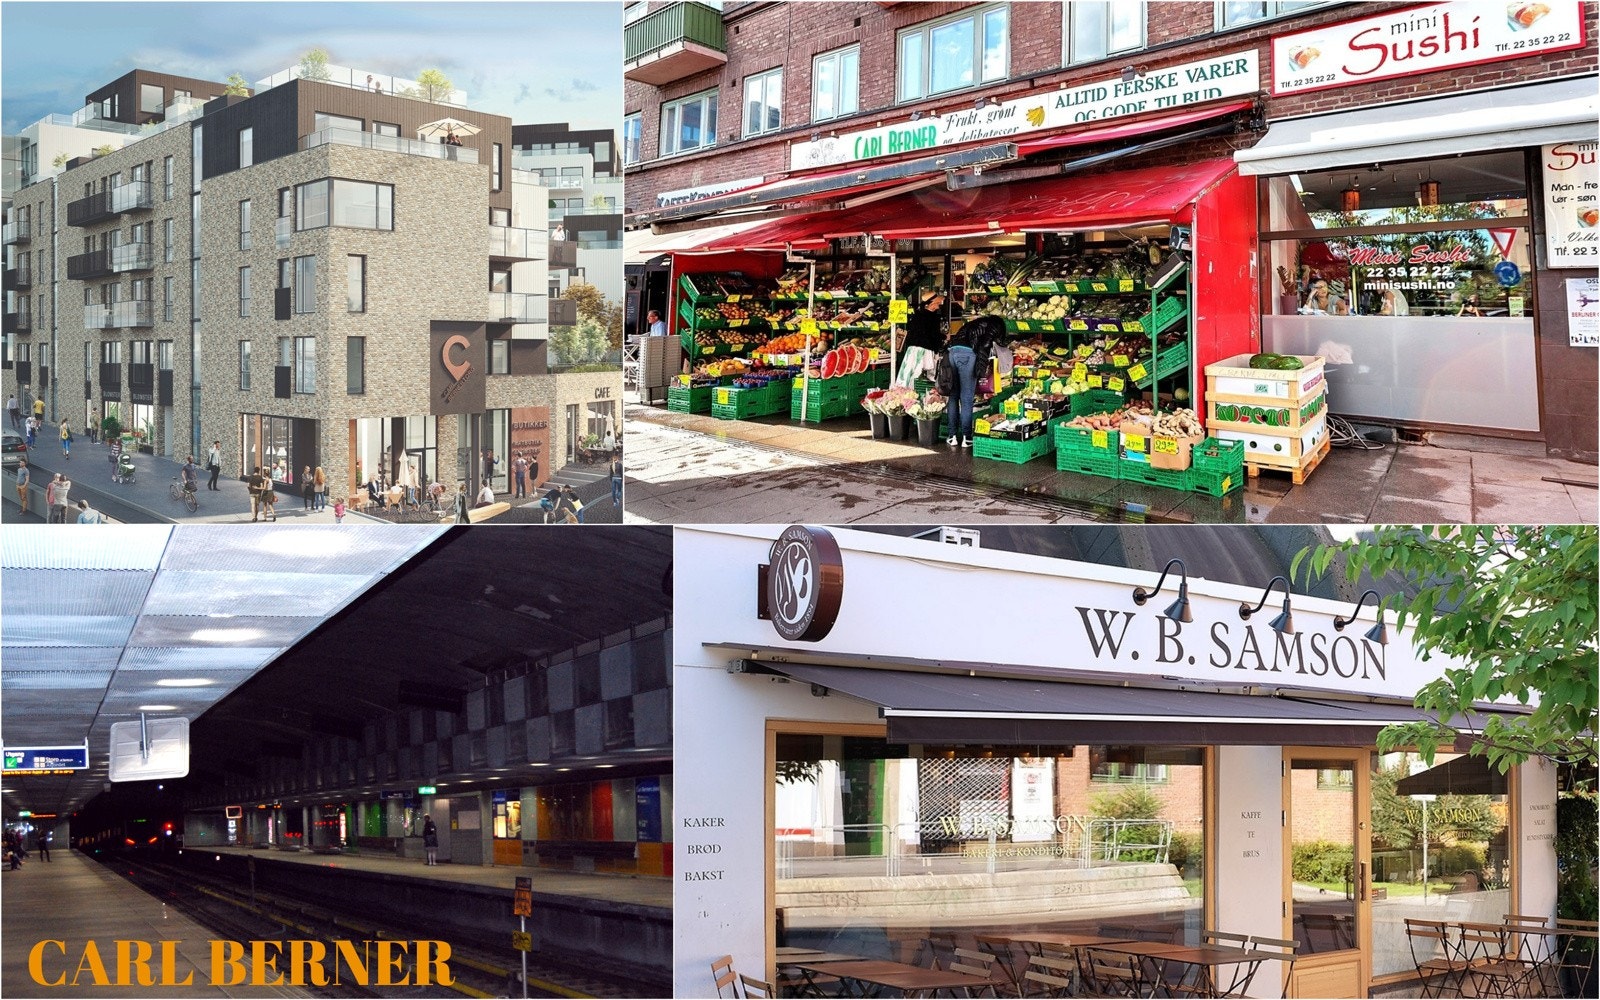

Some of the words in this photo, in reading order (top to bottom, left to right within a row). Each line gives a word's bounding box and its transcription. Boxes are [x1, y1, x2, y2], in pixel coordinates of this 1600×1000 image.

[1391, 9, 1437, 35] mini
[1341, 12, 1480, 75] Sushi
[1494, 43, 1510, 52] Tlf.
[1513, 40, 1525, 49] 22
[1528, 38, 1540, 46] 35
[1543, 35, 1555, 44] 22
[1558, 32, 1570, 41] 22
[1055, 87, 1108, 109] ALLTID
[1113, 72, 1178, 98] FERSKE
[1185, 58, 1249, 84] VARER
[1315, 75, 1324, 83] 22
[1326, 73, 1336, 81] 22
[1551, 183, 1574, 192] Man
[1552, 194, 1568, 203] Lør
[1577, 194, 1597, 202] søn
[1349, 248, 1401, 265] Mini
[1408, 244, 1472, 264] Sushi
[1573, 246, 1588, 256] 22
[1366, 268, 1384, 278] 22
[1388, 267, 1407, 277] 35
[1409, 266, 1428, 277] 22
[1431, 265, 1451, 276] 22
[1363, 279, 1456, 291] minisushi.no
[594, 386, 611, 399] CAFE
[1075, 606, 1140, 661] W.
[1155, 615, 1196, 666] B.
[1209, 621, 1390, 682] SAMSON
[1241, 811, 1261, 819] KAFFE
[1433, 807, 1480, 823] SAMSON
[683, 817, 725, 828] KAKER
[997, 814, 1087, 835] SAMSON
[1247, 830, 1255, 838] TE
[687, 844, 722, 855] BRØD
[685, 870, 725, 882] BAKST
